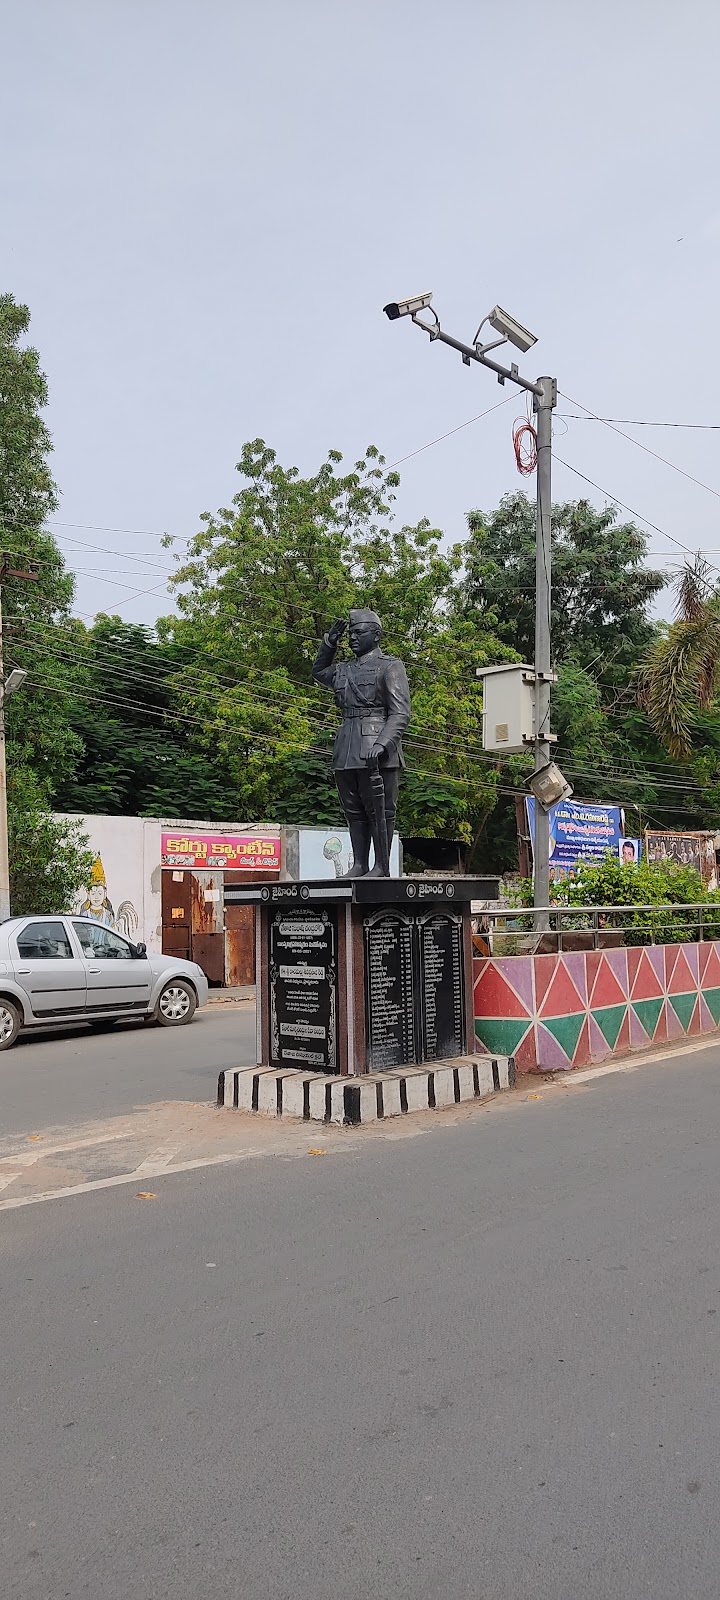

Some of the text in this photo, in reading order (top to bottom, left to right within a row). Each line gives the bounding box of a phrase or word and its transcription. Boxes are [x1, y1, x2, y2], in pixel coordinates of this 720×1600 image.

[166, 837, 275, 859] కోర్టు క్యాంటీన్
[272, 885, 298, 900] జైహింద్
[419, 883, 444, 898] జైహింద్
